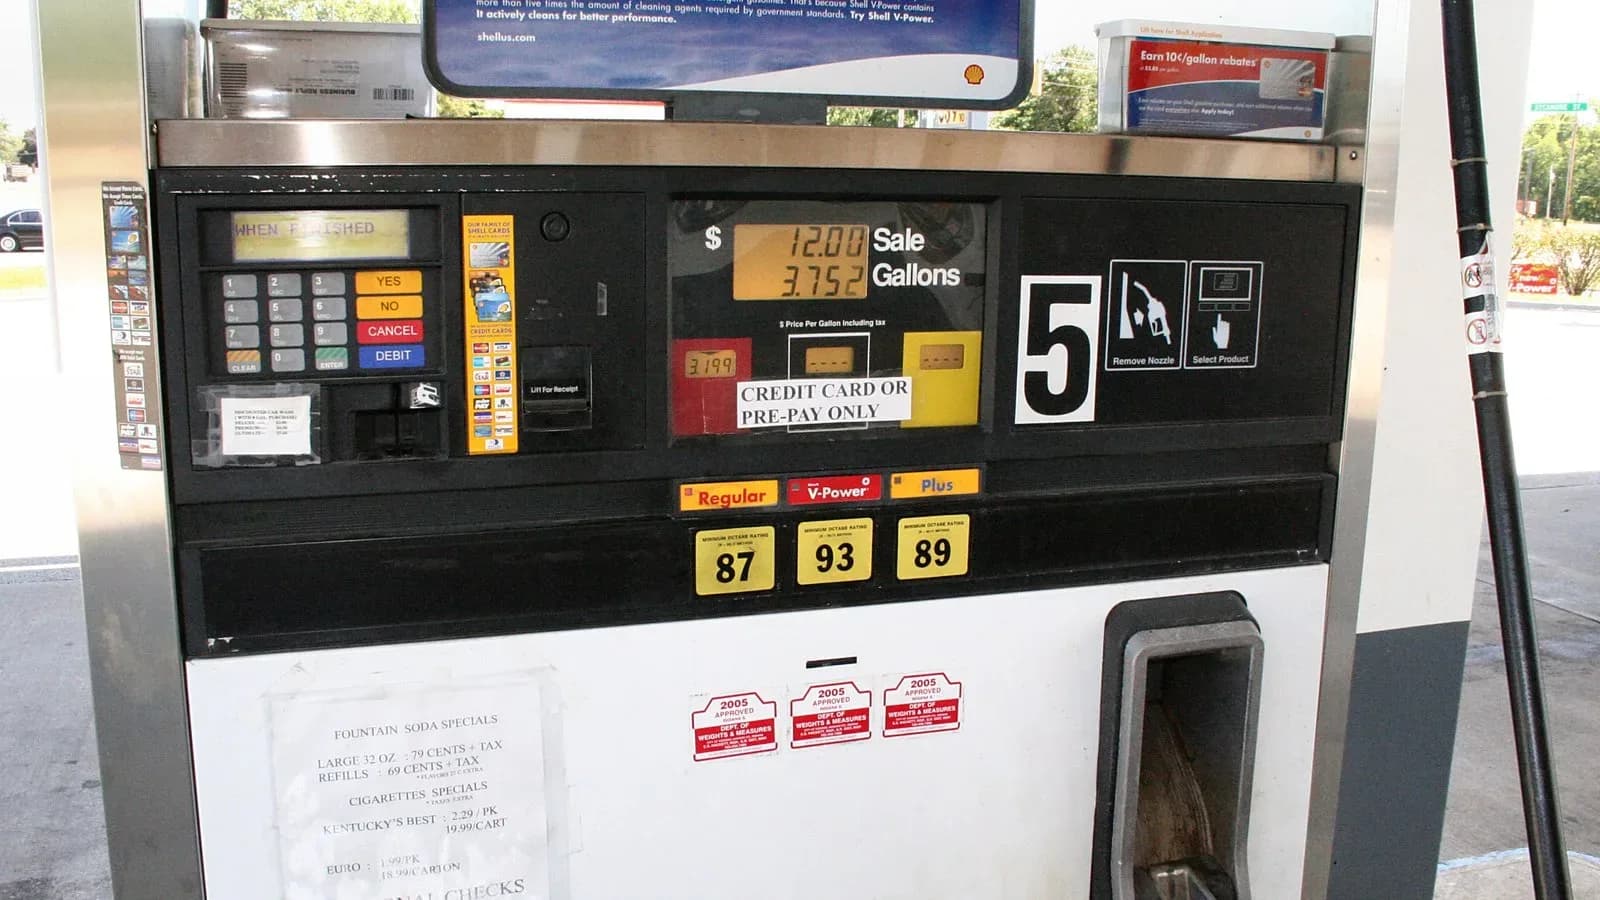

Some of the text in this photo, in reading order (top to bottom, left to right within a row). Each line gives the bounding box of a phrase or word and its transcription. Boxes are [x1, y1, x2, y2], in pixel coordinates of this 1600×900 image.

[545, 0, 567, 8] times
[571, 0, 584, 8] the
[588, 1, 620, 9] amount
[623, 0, 632, 10] of
[635, 1, 671, 13] cleaning
[674, 5, 702, 14] agents
[705, 5, 740, 15] required
[743, 5, 753, 16] by
[757, 8, 803, 17] government
[806, 9, 847, 19] standards.
[850, 10, 865, 21] Try
[868, 11, 890, 21] Shell
[893, 13, 934, 23] V-Power.
[849, 0, 868, 8] Shell
[870, 1, 900, 10] V-Power
[904, 4, 934, 12] contains
[476, 9, 677, 23] It actively cleans for better performance.
[477, 32, 536, 42] shellus.com
[1141, 50, 1164, 61] Earn
[235, 223, 278, 237] WHEN
[705, 225, 925, 257] $ 12.00 Sale
[227, 279, 232, 287] 1
[271, 278, 278, 287] 2
[315, 277, 322, 285] 3
[377, 276, 401, 287] YES
[782, 262, 960, 297] 3.752 Gallons
[228, 304, 234, 313] 4
[272, 303, 279, 311] 5
[316, 302, 323, 310] 6
[380, 301, 399, 311] NO
[779, 319, 886, 328] $ Price Per Gallon including tax
[229, 329, 235, 338] 7
[273, 328, 280, 336] 8
[317, 326, 324, 335] 9
[368, 325, 418, 337] CANCEL
[1023, 283, 1092, 416] 5
[275, 354, 282, 362] 0
[375, 350, 412, 361] DEBIT
[1113, 356, 1175, 366] Remove Nozzle
[1192, 355, 1249, 365] Select Product
[232, 364, 257, 372] CLEAR
[320, 361, 344, 369] ENTER
[553, 385, 579, 393] Receipt
[741, 380, 909, 403] CREDIT CARD OR
[741, 404, 881, 425] PRE-PAY ONLY
[921, 479, 953, 493] Plus
[808, 486, 867, 500] V-Power
[698, 490, 767, 509] Regular
[815, 543, 855, 573] 93
[914, 538, 952, 569] 89
[715, 551, 756, 584] 87
[910, 679, 937, 688] 2005
[818, 688, 845, 698] 2005
[905, 688, 942, 696] APPROVED
[720, 699, 748, 710] 2005
[812, 697, 851, 706] APPROVED
[714, 708, 754, 718] APPROVED
[888, 710, 916, 718] WEIGHTS
[922, 705, 956, 714] MEASURES
[334, 714, 498, 740] FOUNTAIN SODA SPECIALS
[795, 721, 825, 729] WEIGHTS
[832, 715, 867, 724] MEASURES
[697, 732, 729, 741] WEIGHTS
[735, 726, 772, 736] MEASURES
[317, 739, 503, 769] LARGE 32 OZ 79 CENTS TAX
[319, 769, 369, 783] REFILLS
[387, 765, 401, 777] 69
[403, 761, 444, 775] CENTS
[455, 755, 480, 767] TAX
[349, 781, 488, 807] CIGARETTES SPECIALS
[323, 806, 498, 835] KENTUCKY'S BEST 2.29 PK
[446, 817, 508, 834] 19.99/CART
[326, 862, 361, 875] EURO
[444, 878, 525, 900] CHECKS
